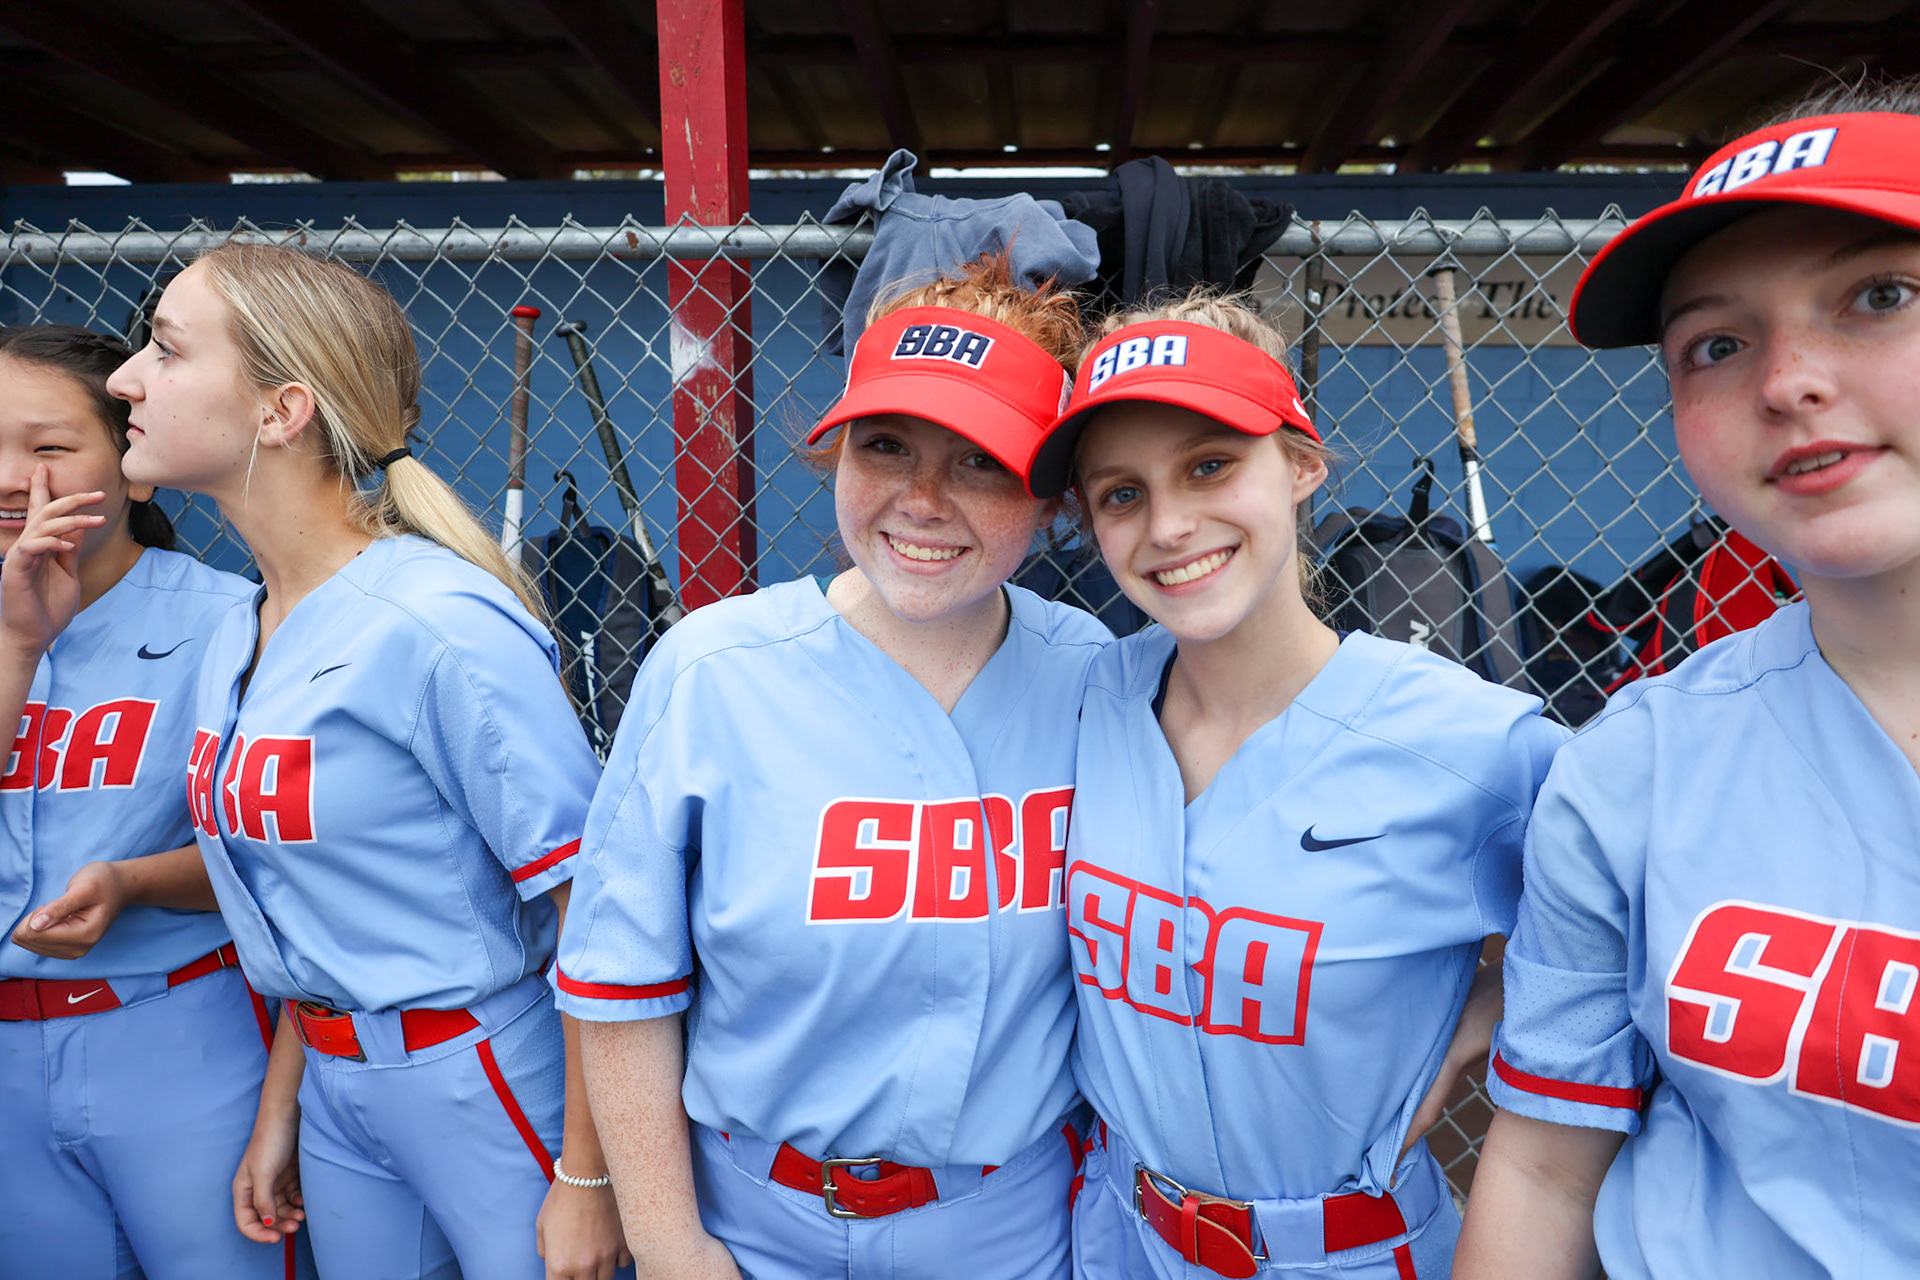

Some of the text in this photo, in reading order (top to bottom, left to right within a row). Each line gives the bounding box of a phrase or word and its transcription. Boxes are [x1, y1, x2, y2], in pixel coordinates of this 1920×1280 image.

[891, 324, 996, 370] SBA
[1320, 278, 1558, 320] Protec The
[1088, 335, 1189, 394] SBA
[0, 697, 161, 793] BA
[805, 784, 1075, 926] SBA
[1065, 860, 1325, 1047] SBA
[1664, 899, 1920, 1130] SB
